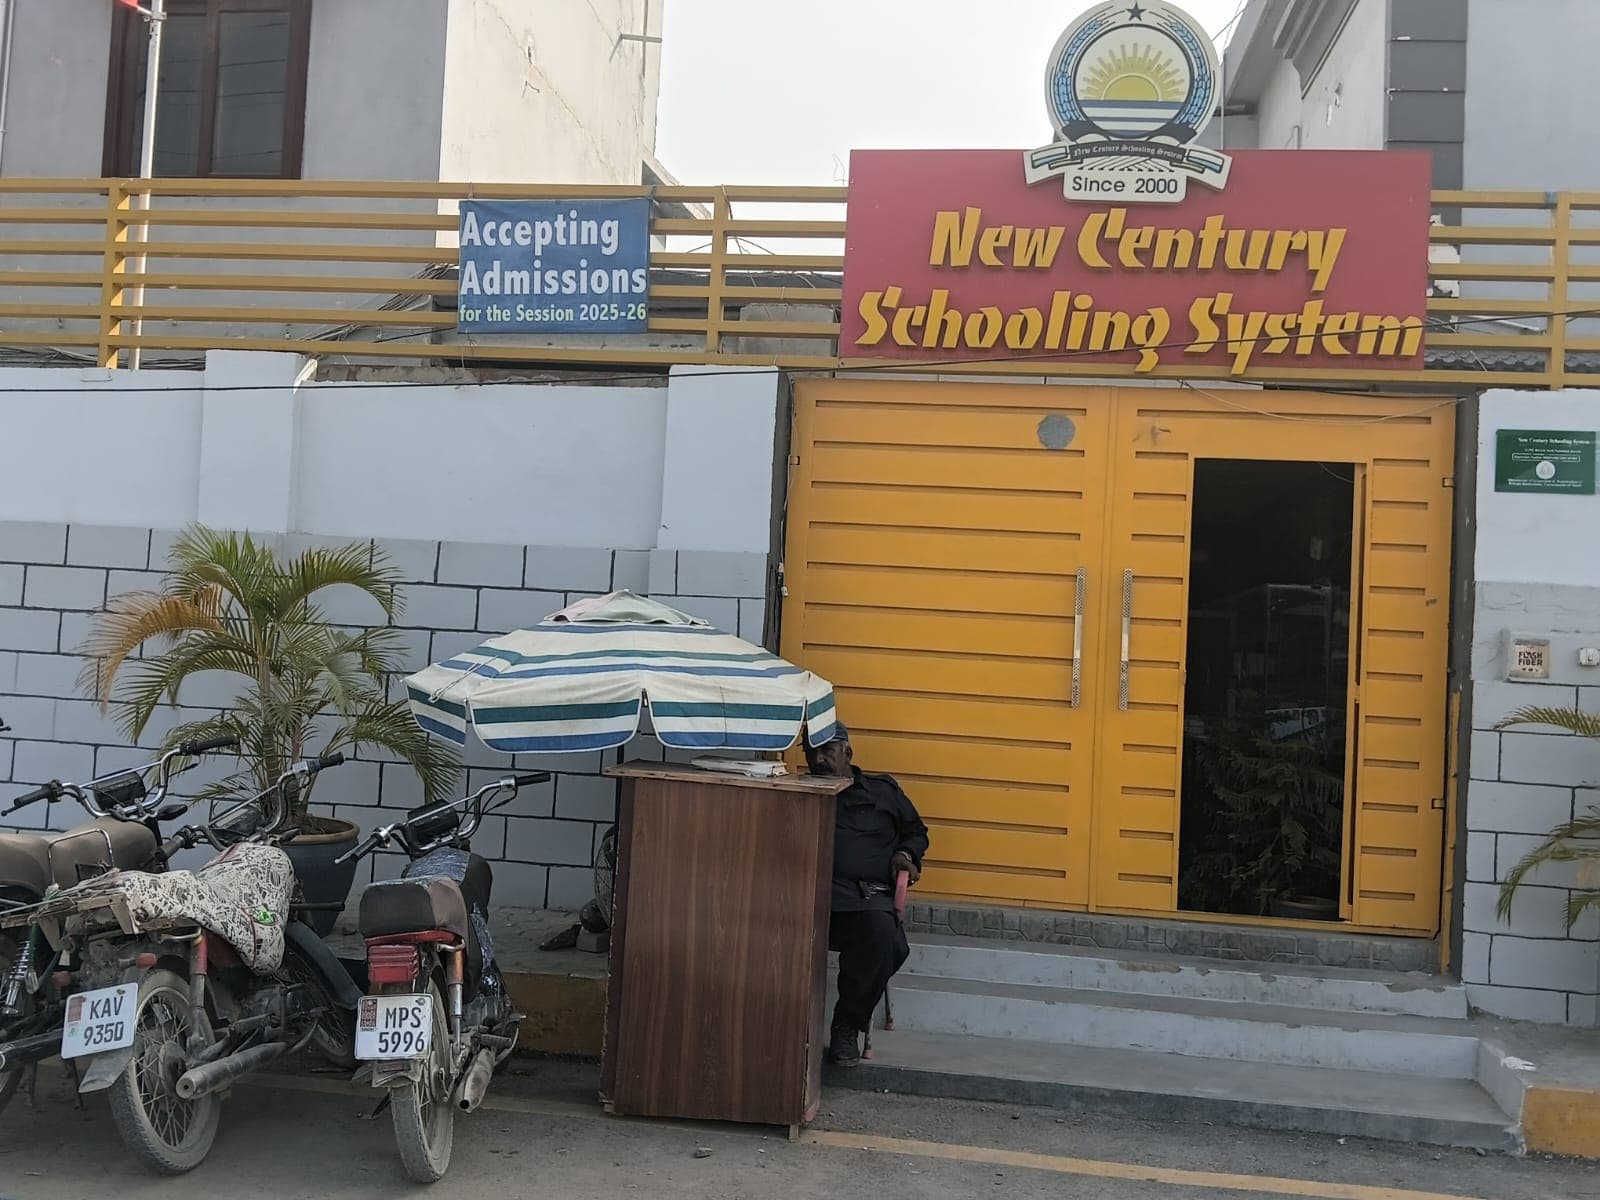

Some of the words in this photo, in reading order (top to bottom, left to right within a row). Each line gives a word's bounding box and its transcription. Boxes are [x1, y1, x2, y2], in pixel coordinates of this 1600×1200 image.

[1072, 175, 1126, 192] Since
[1134, 177, 1178, 194] 2000
[460, 209, 619, 256] Accepting
[929, 206, 1066, 268] New
[1077, 207, 1347, 292] Century
[460, 258, 647, 295] Admissions
[459, 304, 482, 322] for
[486, 304, 511, 322] the
[515, 303, 574, 322] Session
[579, 303, 647, 321] 2025-26
[854, 285, 1171, 373] Schooling
[1183, 292, 1423, 375] System
[89, 996, 124, 1020] KAV
[385, 1007, 422, 1029] MPS
[83, 1021, 124, 1047] 9350
[378, 1030, 425, 1053] 5996
